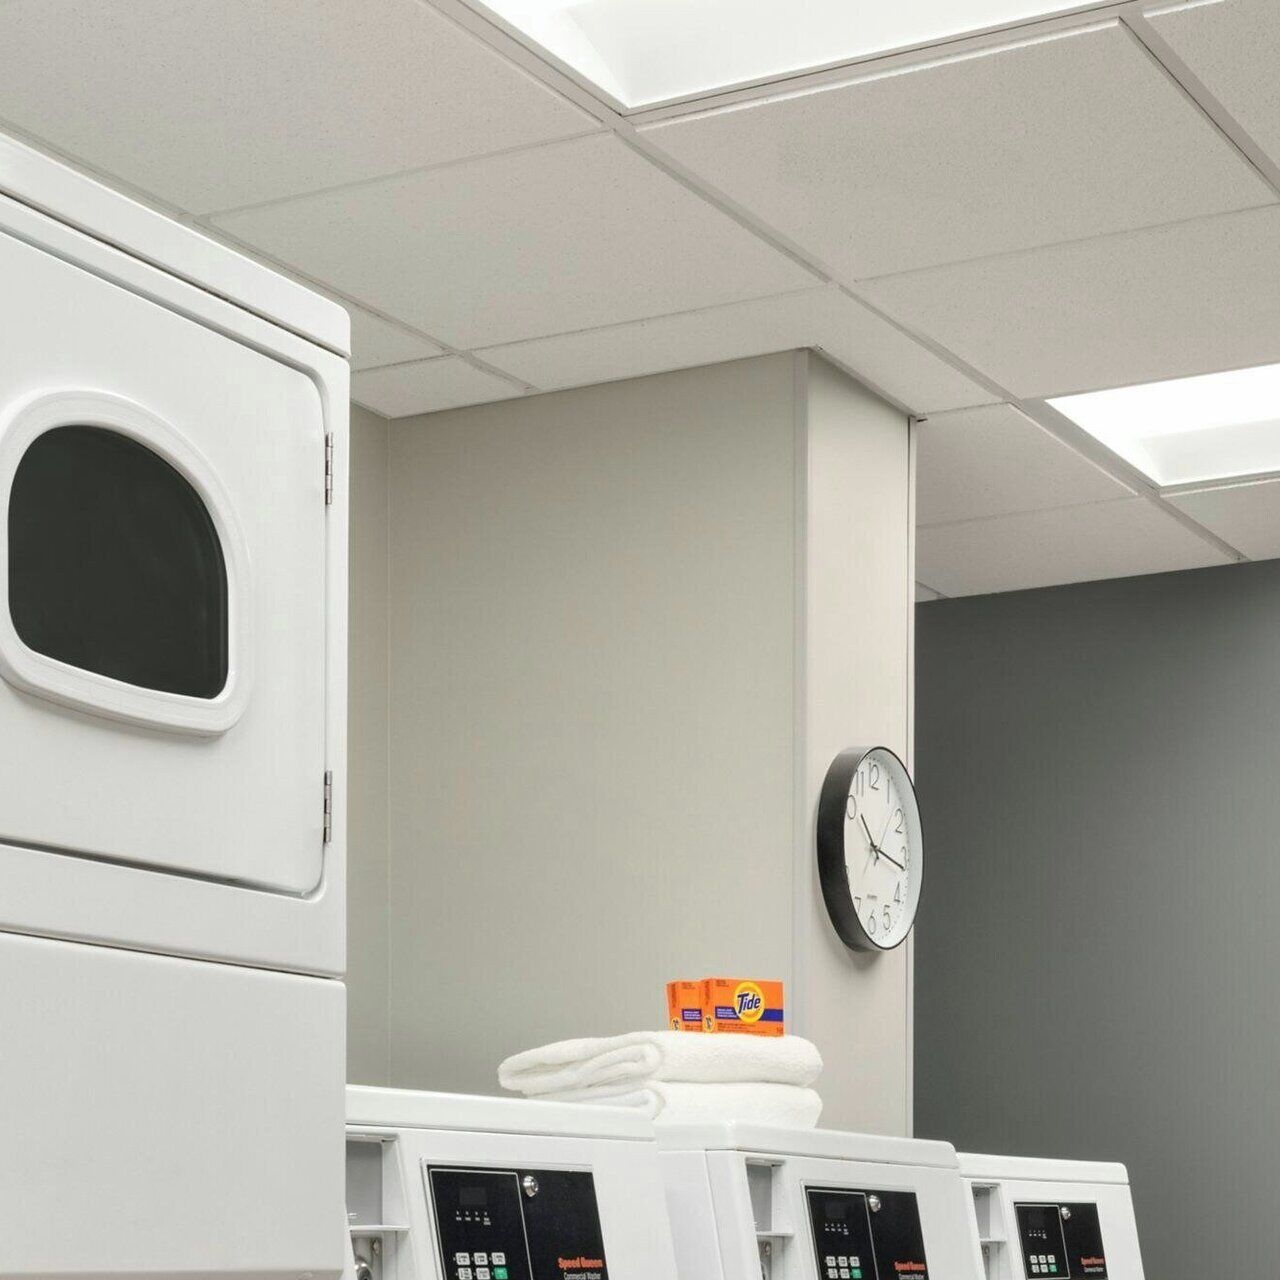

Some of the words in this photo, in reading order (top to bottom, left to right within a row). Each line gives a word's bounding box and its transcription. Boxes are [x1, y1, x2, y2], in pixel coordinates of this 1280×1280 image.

[867, 762, 880, 791] 12
[894, 808, 904, 834] 2
[893, 881, 901, 905] 4
[868, 908, 876, 935] 6
[882, 904, 891, 931] 5
[736, 992, 762, 1014] Tide
